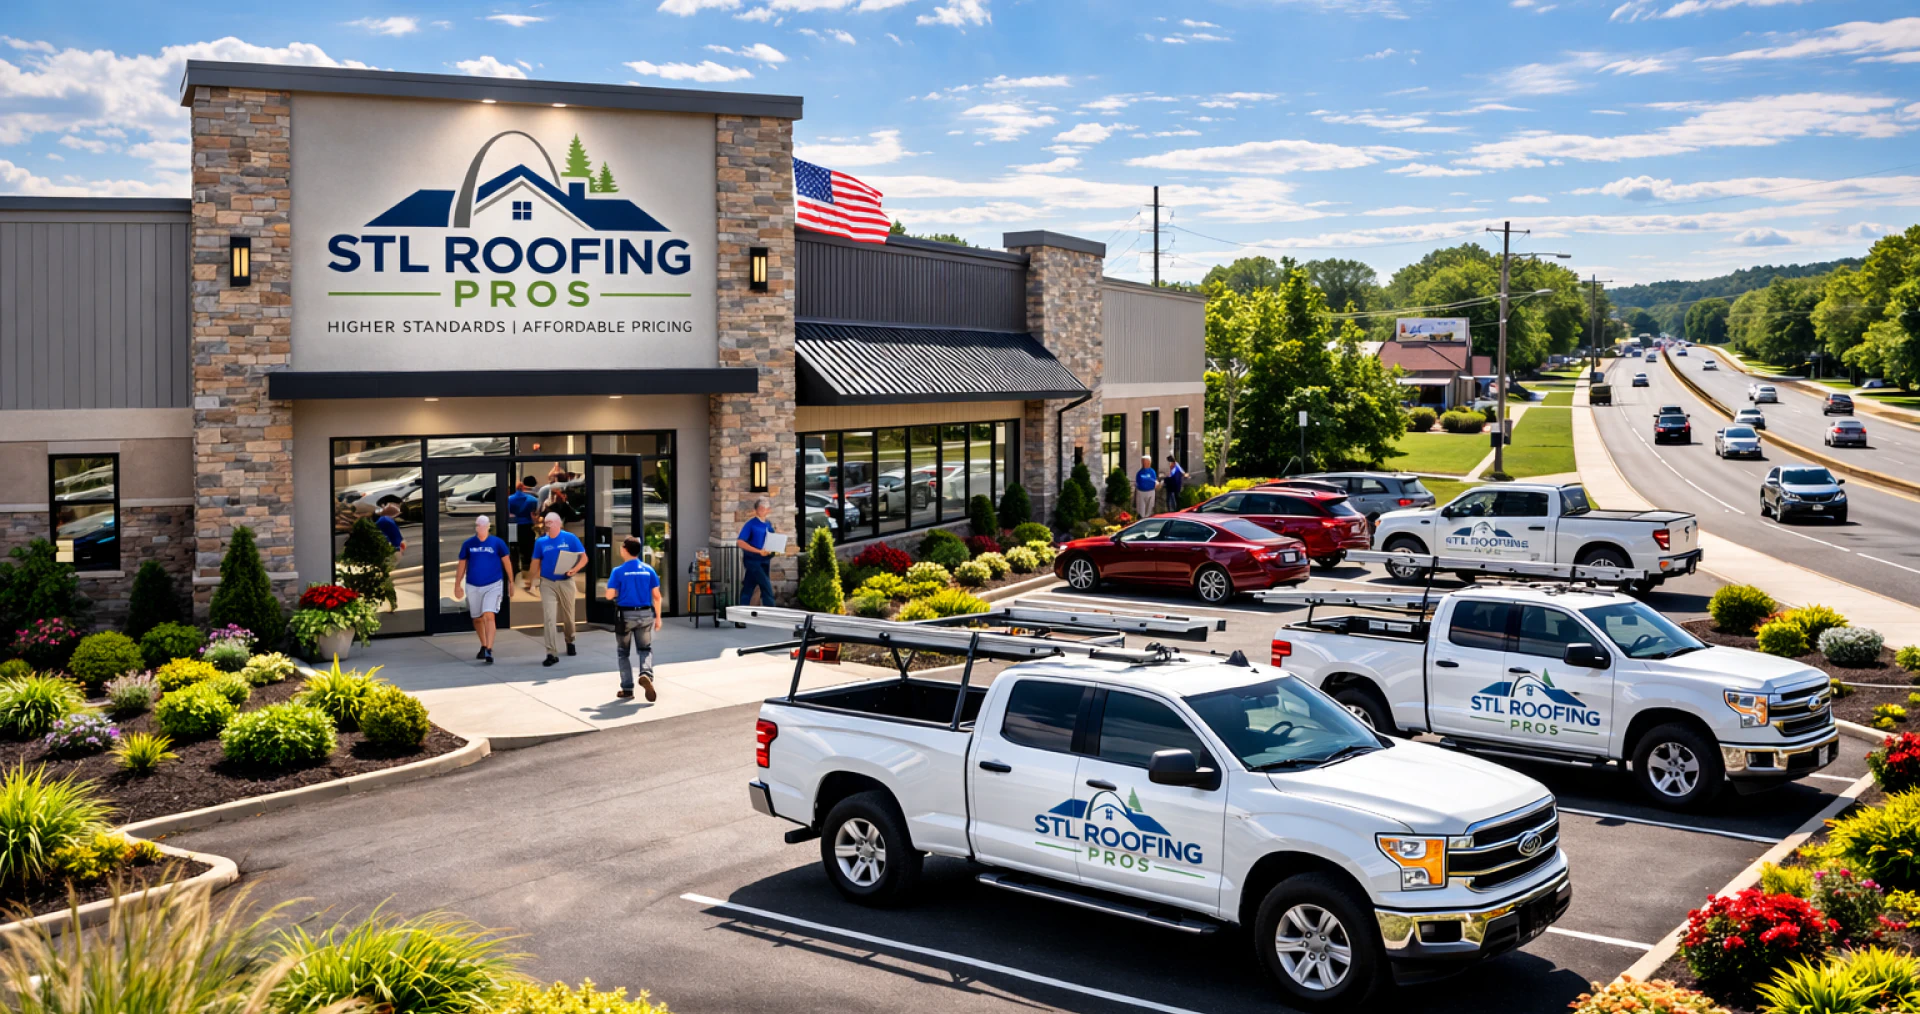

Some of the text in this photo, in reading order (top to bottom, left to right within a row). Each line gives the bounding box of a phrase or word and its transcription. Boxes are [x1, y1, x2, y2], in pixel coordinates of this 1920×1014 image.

[328, 234, 691, 275] STL ROOFING
[455, 280, 590, 308] PROS
[327, 320, 395, 333] HIGHER
[403, 320, 506, 333] STANDARDS
[522, 320, 625, 333] AFFORDABLE
[632, 320, 692, 333] PRICING
[1471, 695, 1601, 726] STL ROOFING
[1510, 719, 1559, 736] PROS
[1034, 814, 1204, 865] STL ROOFING
[1088, 847, 1150, 873] PROS
